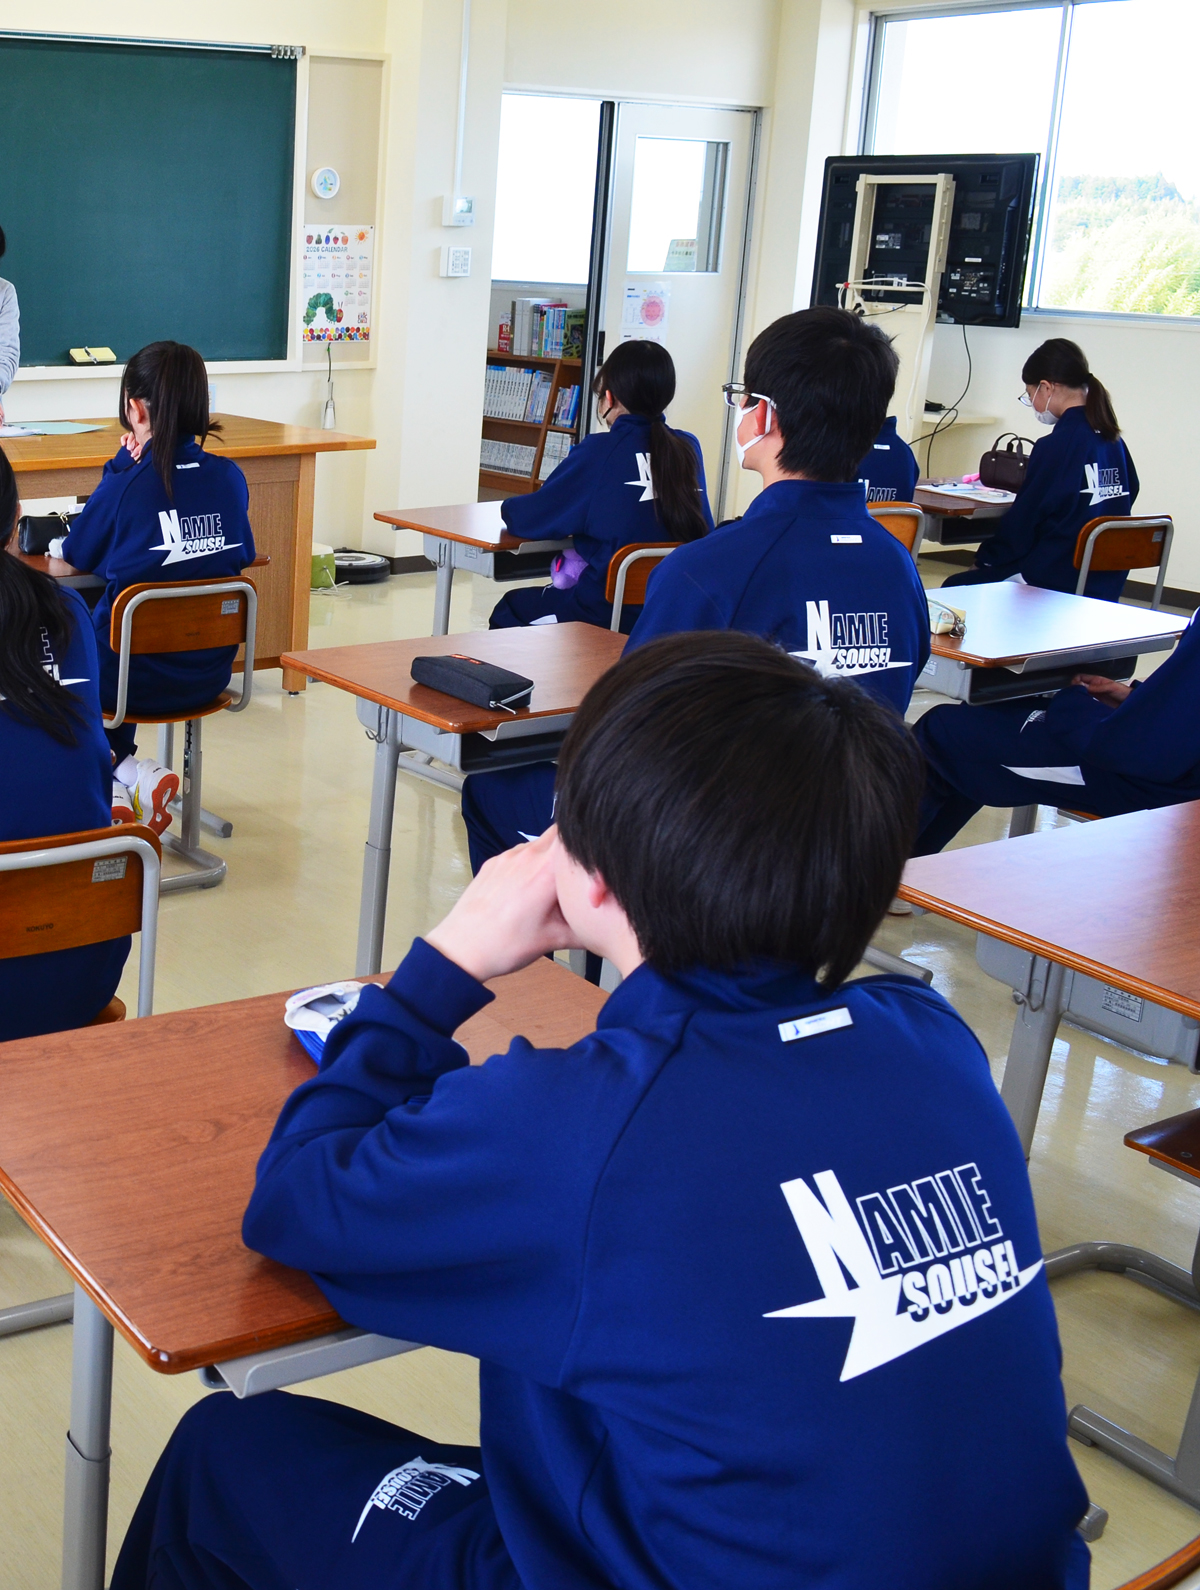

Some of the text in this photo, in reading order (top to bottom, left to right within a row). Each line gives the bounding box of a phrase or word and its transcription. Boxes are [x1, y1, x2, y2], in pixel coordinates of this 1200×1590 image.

[158, 509, 222, 544] NAMIE
[184, 536, 225, 555] SOUSE!
[806, 600, 888, 650] NAMIE
[836, 648, 891, 669] SOUSE!
[780, 1162, 1003, 1297] NAMIE
[902, 1240, 1021, 1322] SOUSE!
